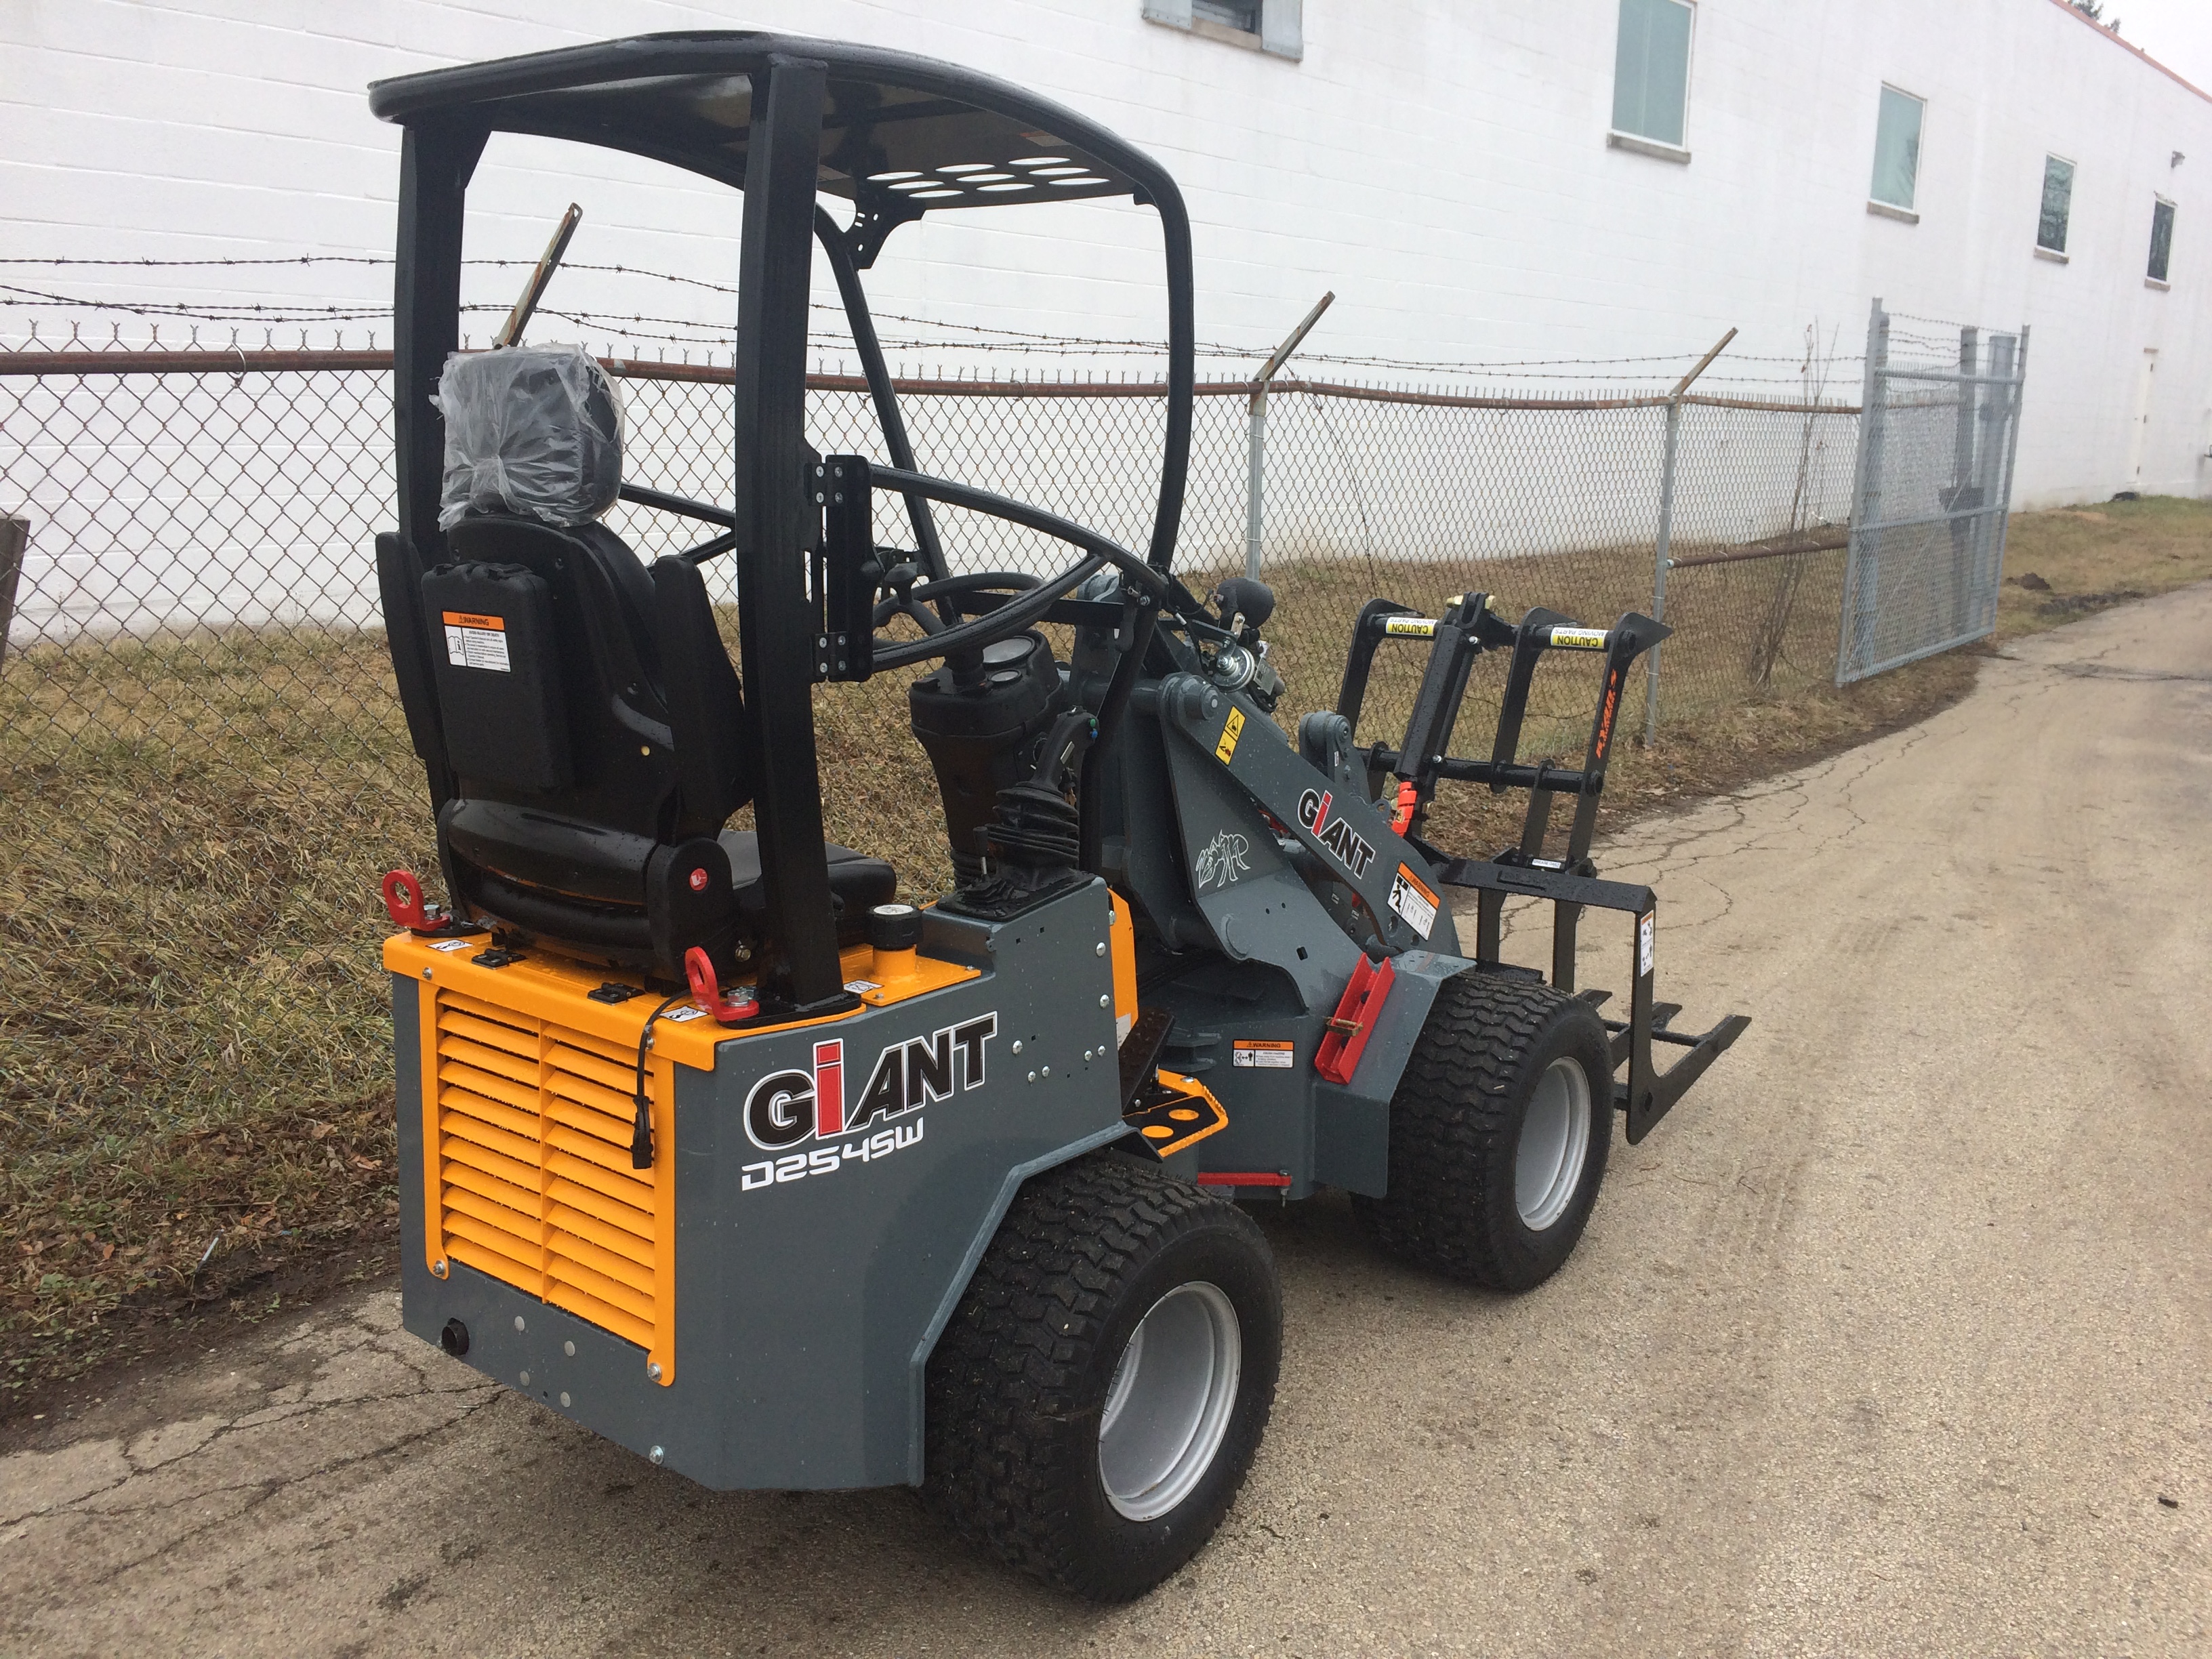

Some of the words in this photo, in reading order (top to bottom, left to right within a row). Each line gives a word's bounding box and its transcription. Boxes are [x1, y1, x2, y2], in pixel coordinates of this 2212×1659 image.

[464, 617, 489, 626] WARNING
[1392, 623, 1429, 634] CAUTION
[1557, 636, 1598, 647] CAUTION
[1412, 878, 1429, 898] WARNING
[741, 1117, 924, 1191] D254SW
